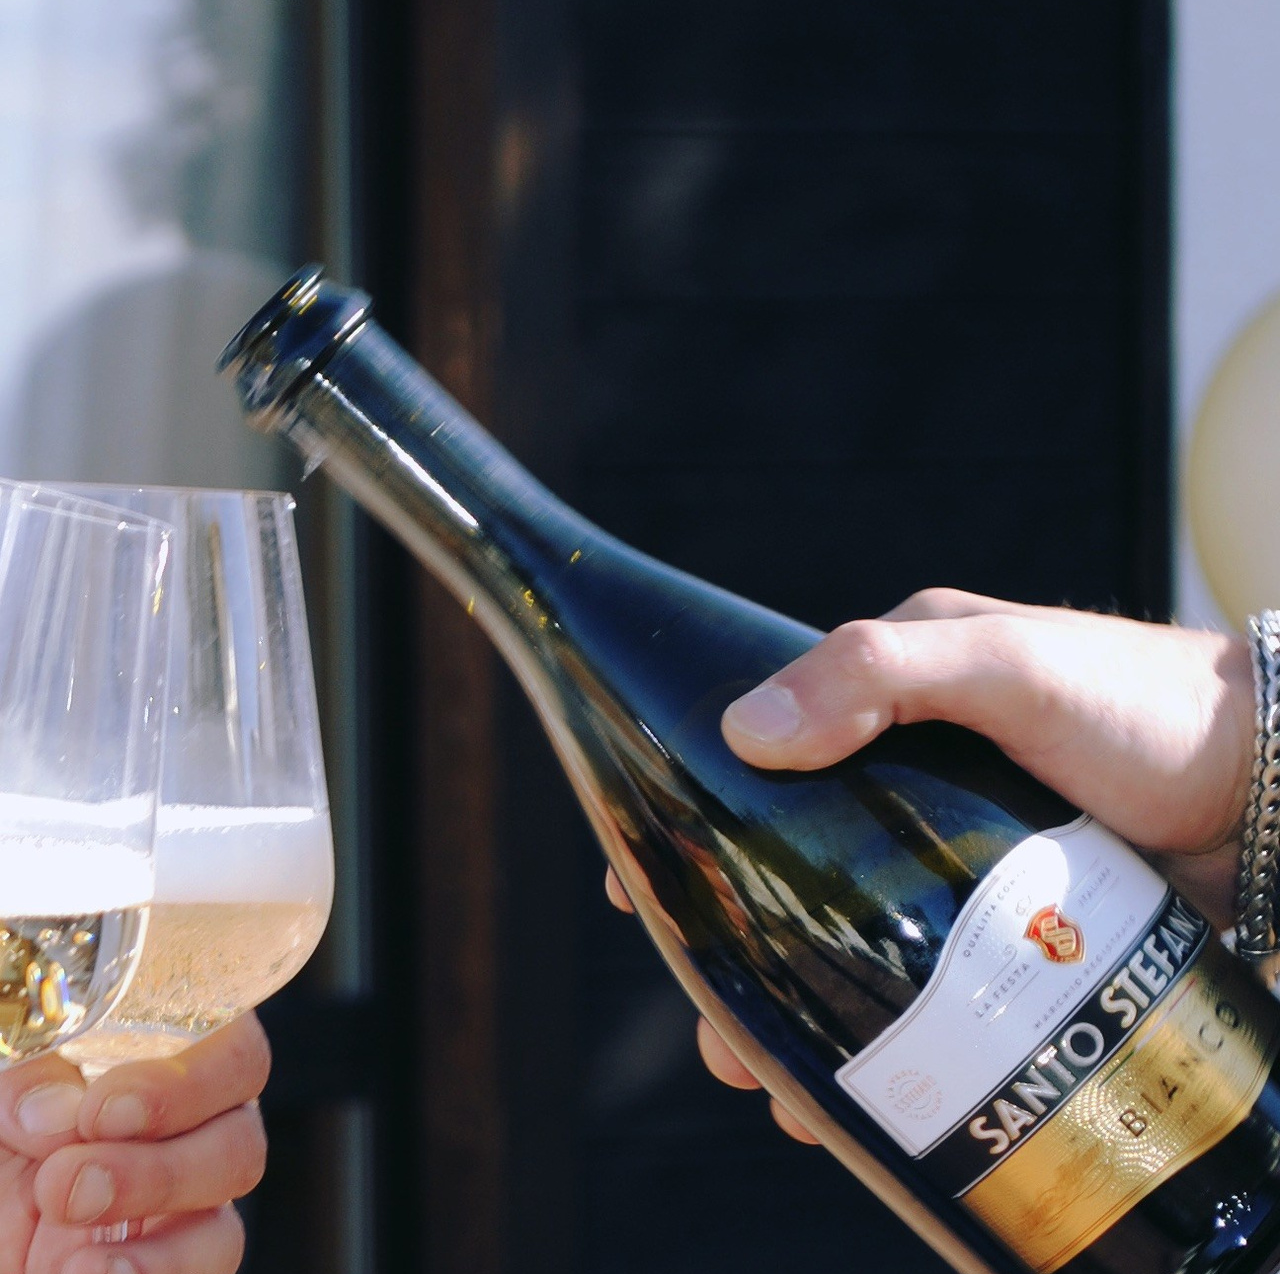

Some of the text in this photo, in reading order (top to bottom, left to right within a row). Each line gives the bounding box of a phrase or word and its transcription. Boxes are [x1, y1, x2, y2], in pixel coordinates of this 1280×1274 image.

[967, 1023, 1105, 1153] SANTO
[1101, 896, 1206, 1026] STEFANO
[972, 962, 1030, 1017] LA FESTA
[1034, 977, 1083, 1029] MARCHIO
[1118, 1001, 1239, 1138] BIANCO
